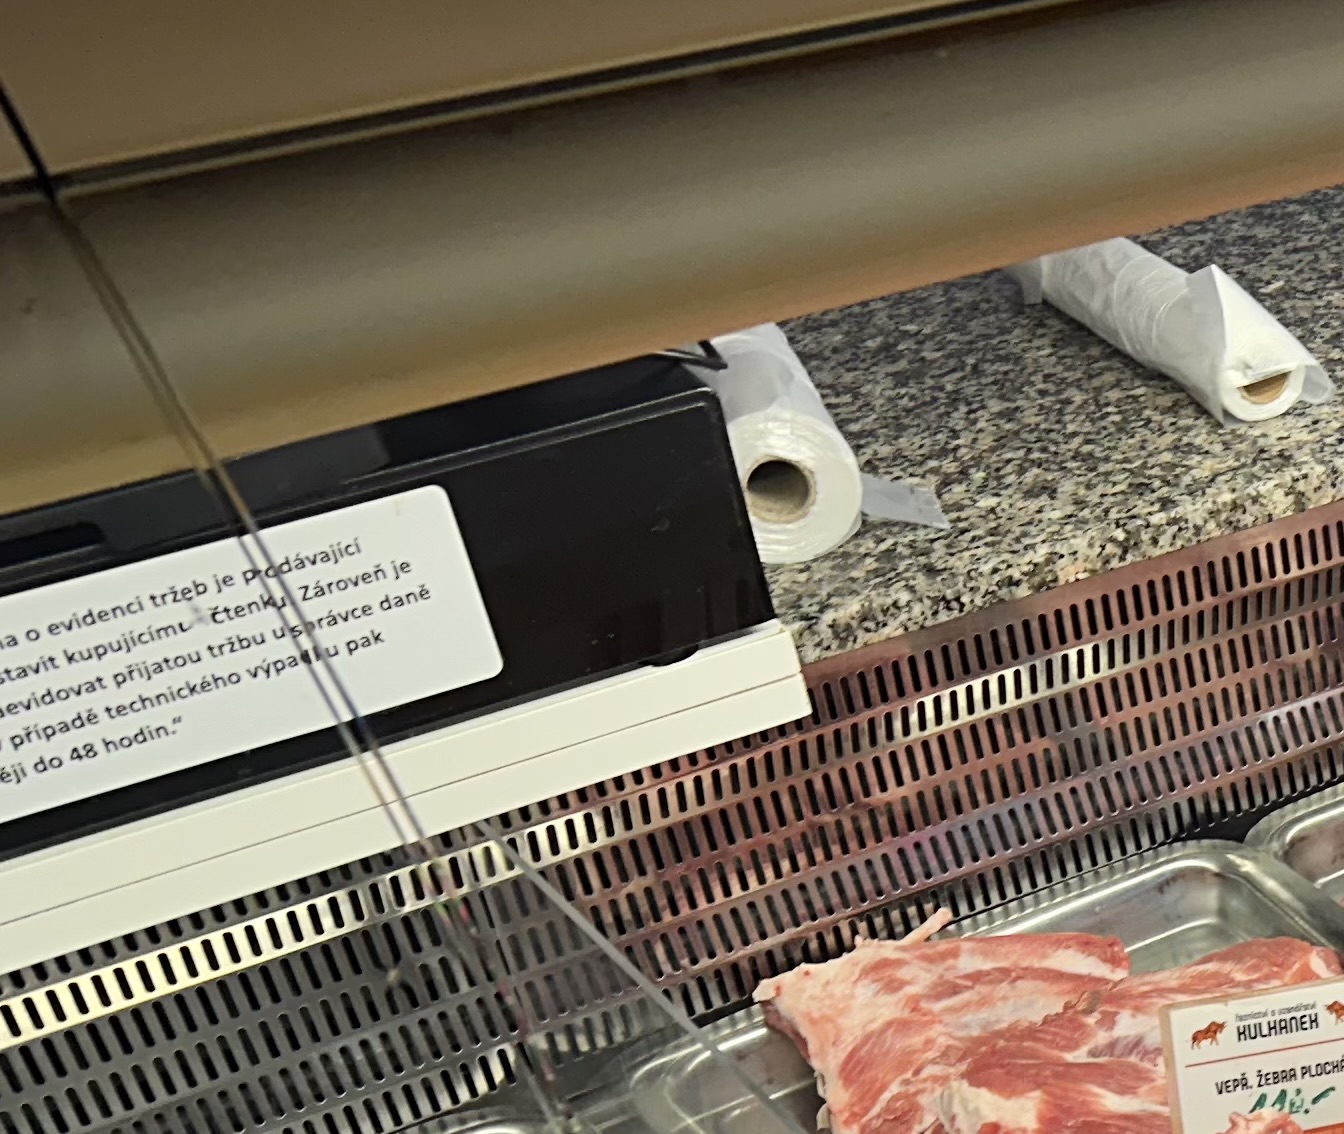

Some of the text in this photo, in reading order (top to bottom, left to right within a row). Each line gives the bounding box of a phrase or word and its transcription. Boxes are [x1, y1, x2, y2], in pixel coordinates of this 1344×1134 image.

[25, 629, 41, 642] o
[48, 596, 146, 636] evidenci
[150, 580, 208, 608] tržeb
[214, 574, 236, 594] je
[63, 621, 191, 666] kupujícímu
[299, 563, 387, 602] Zároveň
[392, 560, 412, 581] je
[113, 649, 202, 689] přijatou
[208, 631, 267, 659] tržbu
[272, 626, 287, 641] u
[379, 583, 432, 613] daně
[9, 707, 101, 751] případě
[105, 671, 242, 721] technického
[345, 629, 385, 656] pak
[33, 755, 63, 775] do
[69, 742, 99, 763] 48
[1214, 1071, 1253, 1095] VEPŘ.
[1255, 1068, 1297, 1088] ŽEBRA
